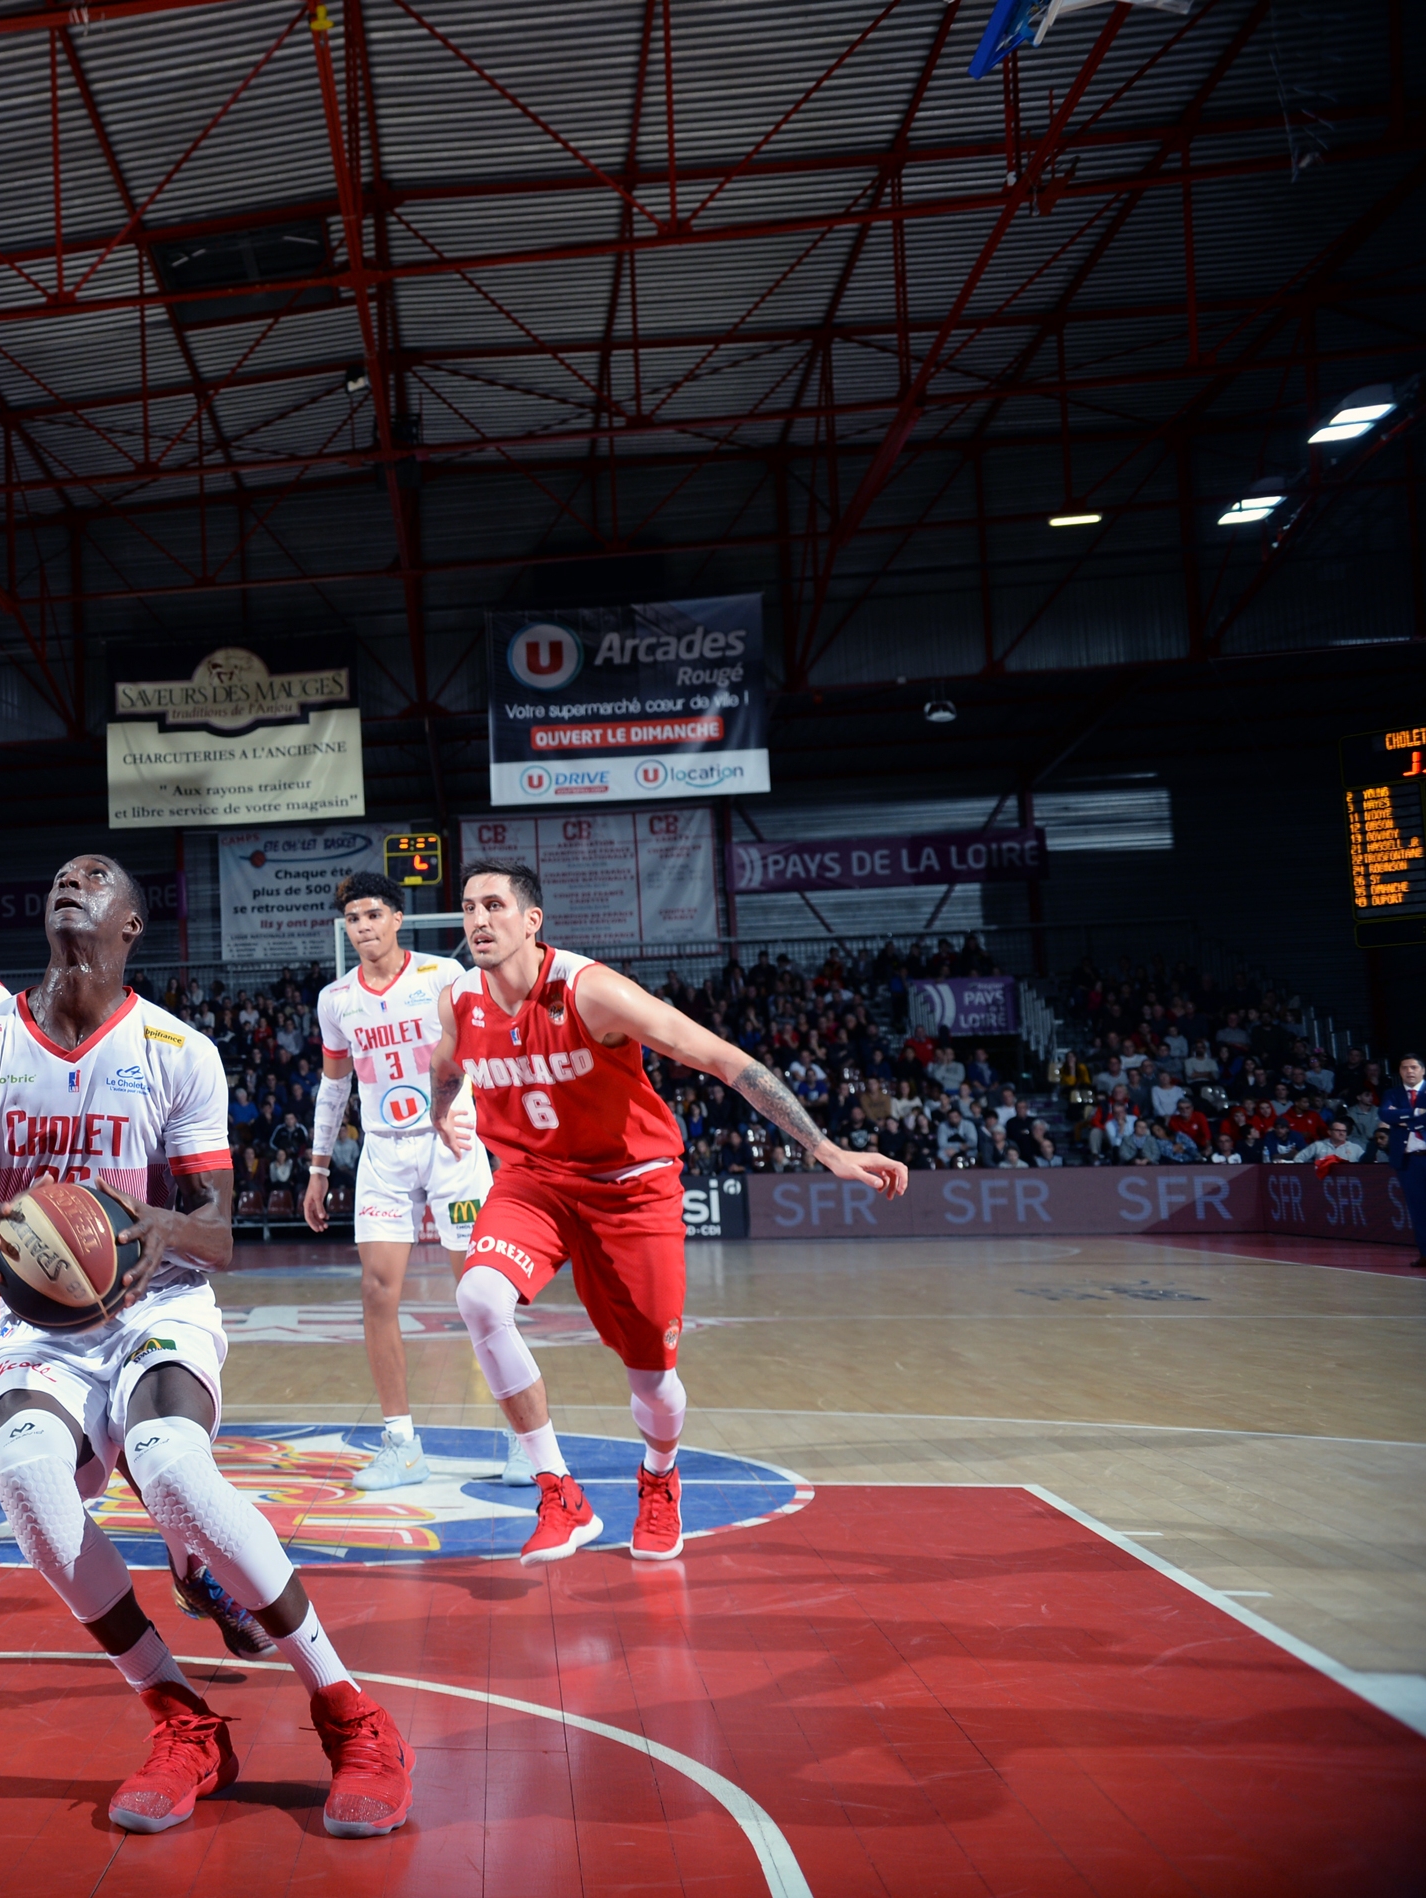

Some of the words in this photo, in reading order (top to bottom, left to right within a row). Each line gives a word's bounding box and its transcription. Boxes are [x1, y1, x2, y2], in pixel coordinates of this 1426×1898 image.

[526, 641, 563, 675] U
[594, 626, 746, 666] Arcades
[676, 662, 744, 687] Rougé
[121, 686, 208, 709] SAVEURS
[212, 683, 250, 704] DES
[255, 672, 345, 703] MAUGES
[171, 705, 228, 719] traditions
[231, 703, 244, 716] de
[248, 702, 293, 717] l'Anjou
[505, 704, 545, 719] Votre
[549, 697, 641, 720] supermarché
[690, 694, 709, 707] de
[535, 728, 602, 746] OUVERT
[607, 727, 626, 742] LE
[631, 722, 719, 741] DIMANCHE
[123, 749, 236, 766] CHARCUTERIES
[252, 741, 347, 759] L'ANCIENNE
[528, 774, 544, 788] U
[555, 770, 610, 786] DRIVE
[643, 769, 659, 782] U
[671, 763, 744, 782] location
[171, 784, 201, 797] Aux
[206, 784, 253, 799] rayons
[259, 780, 312, 792] traiteur
[1346, 792, 1353, 802] 2
[1363, 787, 1390, 800] YOUNG
[115, 808, 127, 819] et
[132, 805, 164, 818] libre
[169, 804, 219, 817] service
[224, 803, 241, 815] de
[245, 802, 280, 814] votre
[1363, 797, 1390, 810] HAYES
[649, 814, 678, 834] CB
[1349, 812, 1359, 823] 11
[478, 824, 507, 844] CB
[563, 820, 591, 841] CB
[1350, 823, 1361, 833] 12
[221, 833, 260, 845] CAMPS
[1351, 833, 1362, 843] 13
[1351, 844, 1362, 854] 21
[766, 852, 841, 880] PAYS
[851, 849, 891, 877] DE
[901, 847, 941, 874] LA
[950, 840, 1040, 871] LOIRE
[1369, 860, 1408, 873] ROBINSON
[275, 868, 327, 881] Chaque
[331, 867, 353, 877] été
[1370, 874, 1381, 884] SY
[253, 886, 280, 900] plus
[284, 885, 301, 896] de
[306, 885, 331, 895] 500
[1370, 881, 1410, 895] DIMANCHE
[233, 905, 247, 914] se
[251, 902, 325, 913] retrouvent
[276, 921, 284, 931] y
[286, 919, 308, 928] ont
[963, 990, 1004, 1006] PAYS
[959, 1011, 1007, 1028] LOIRE
[145, 1028, 182, 1044] bpifrance
[354, 1018, 423, 1051] CHOLET
[385, 1051, 404, 1081] 3
[462, 1048, 594, 1089] MONACO
[106, 1077, 116, 1086] Le
[390, 1098, 418, 1122] U
[522, 1090, 560, 1130] 6
[5, 1110, 129, 1157] CHOLET
[774, 1182, 878, 1228] SFR
[943, 1178, 1052, 1224] SFR
[1117, 1175, 1233, 1222] SFR
[1268, 1175, 1305, 1222] SFR
[1324, 1176, 1367, 1227] SFR
[476, 1236, 535, 1279] OREZZA
